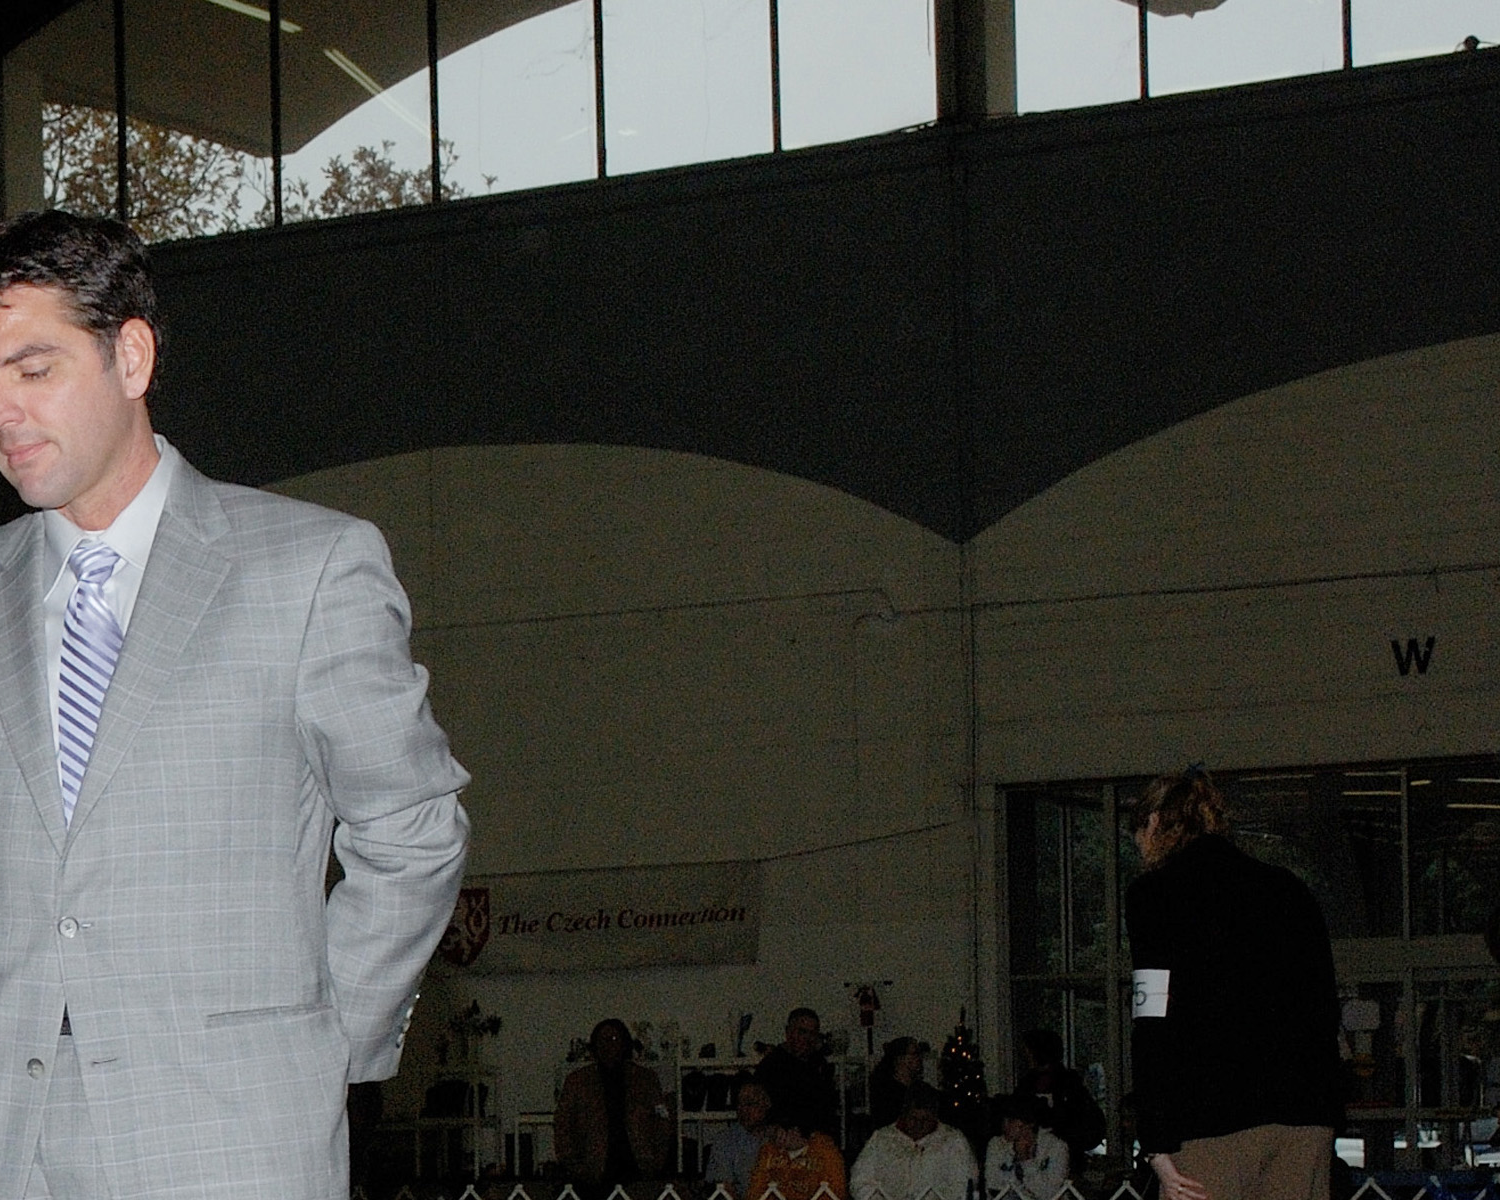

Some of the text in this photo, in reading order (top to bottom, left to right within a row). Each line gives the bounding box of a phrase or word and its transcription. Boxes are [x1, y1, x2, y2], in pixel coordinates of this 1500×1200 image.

[1391, 636, 1435, 676] W
[500, 904, 746, 936] The Czech Connection
